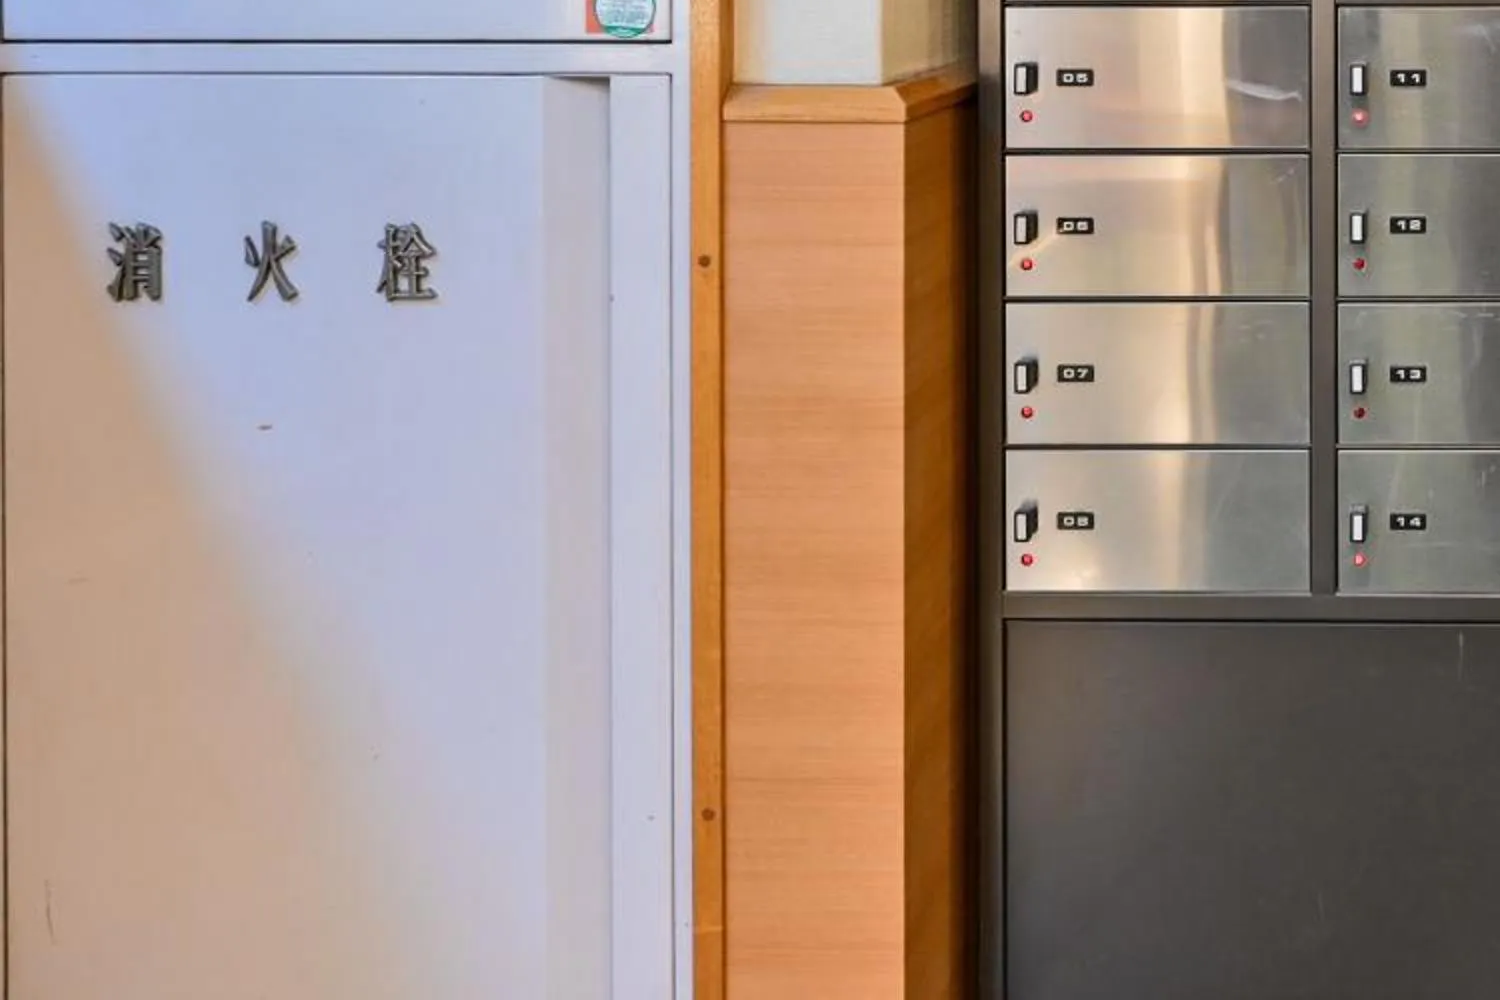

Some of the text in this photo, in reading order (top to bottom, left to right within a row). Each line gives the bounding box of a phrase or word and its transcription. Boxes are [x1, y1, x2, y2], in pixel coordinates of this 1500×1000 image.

[1062, 72, 1089, 83] 05
[1396, 72, 1421, 84] 11
[1062, 219, 1089, 231] 06
[1397, 219, 1422, 231] 12
[1062, 367, 1089, 379] 07
[1396, 368, 1421, 380] 13
[1396, 515, 1421, 527] 14
